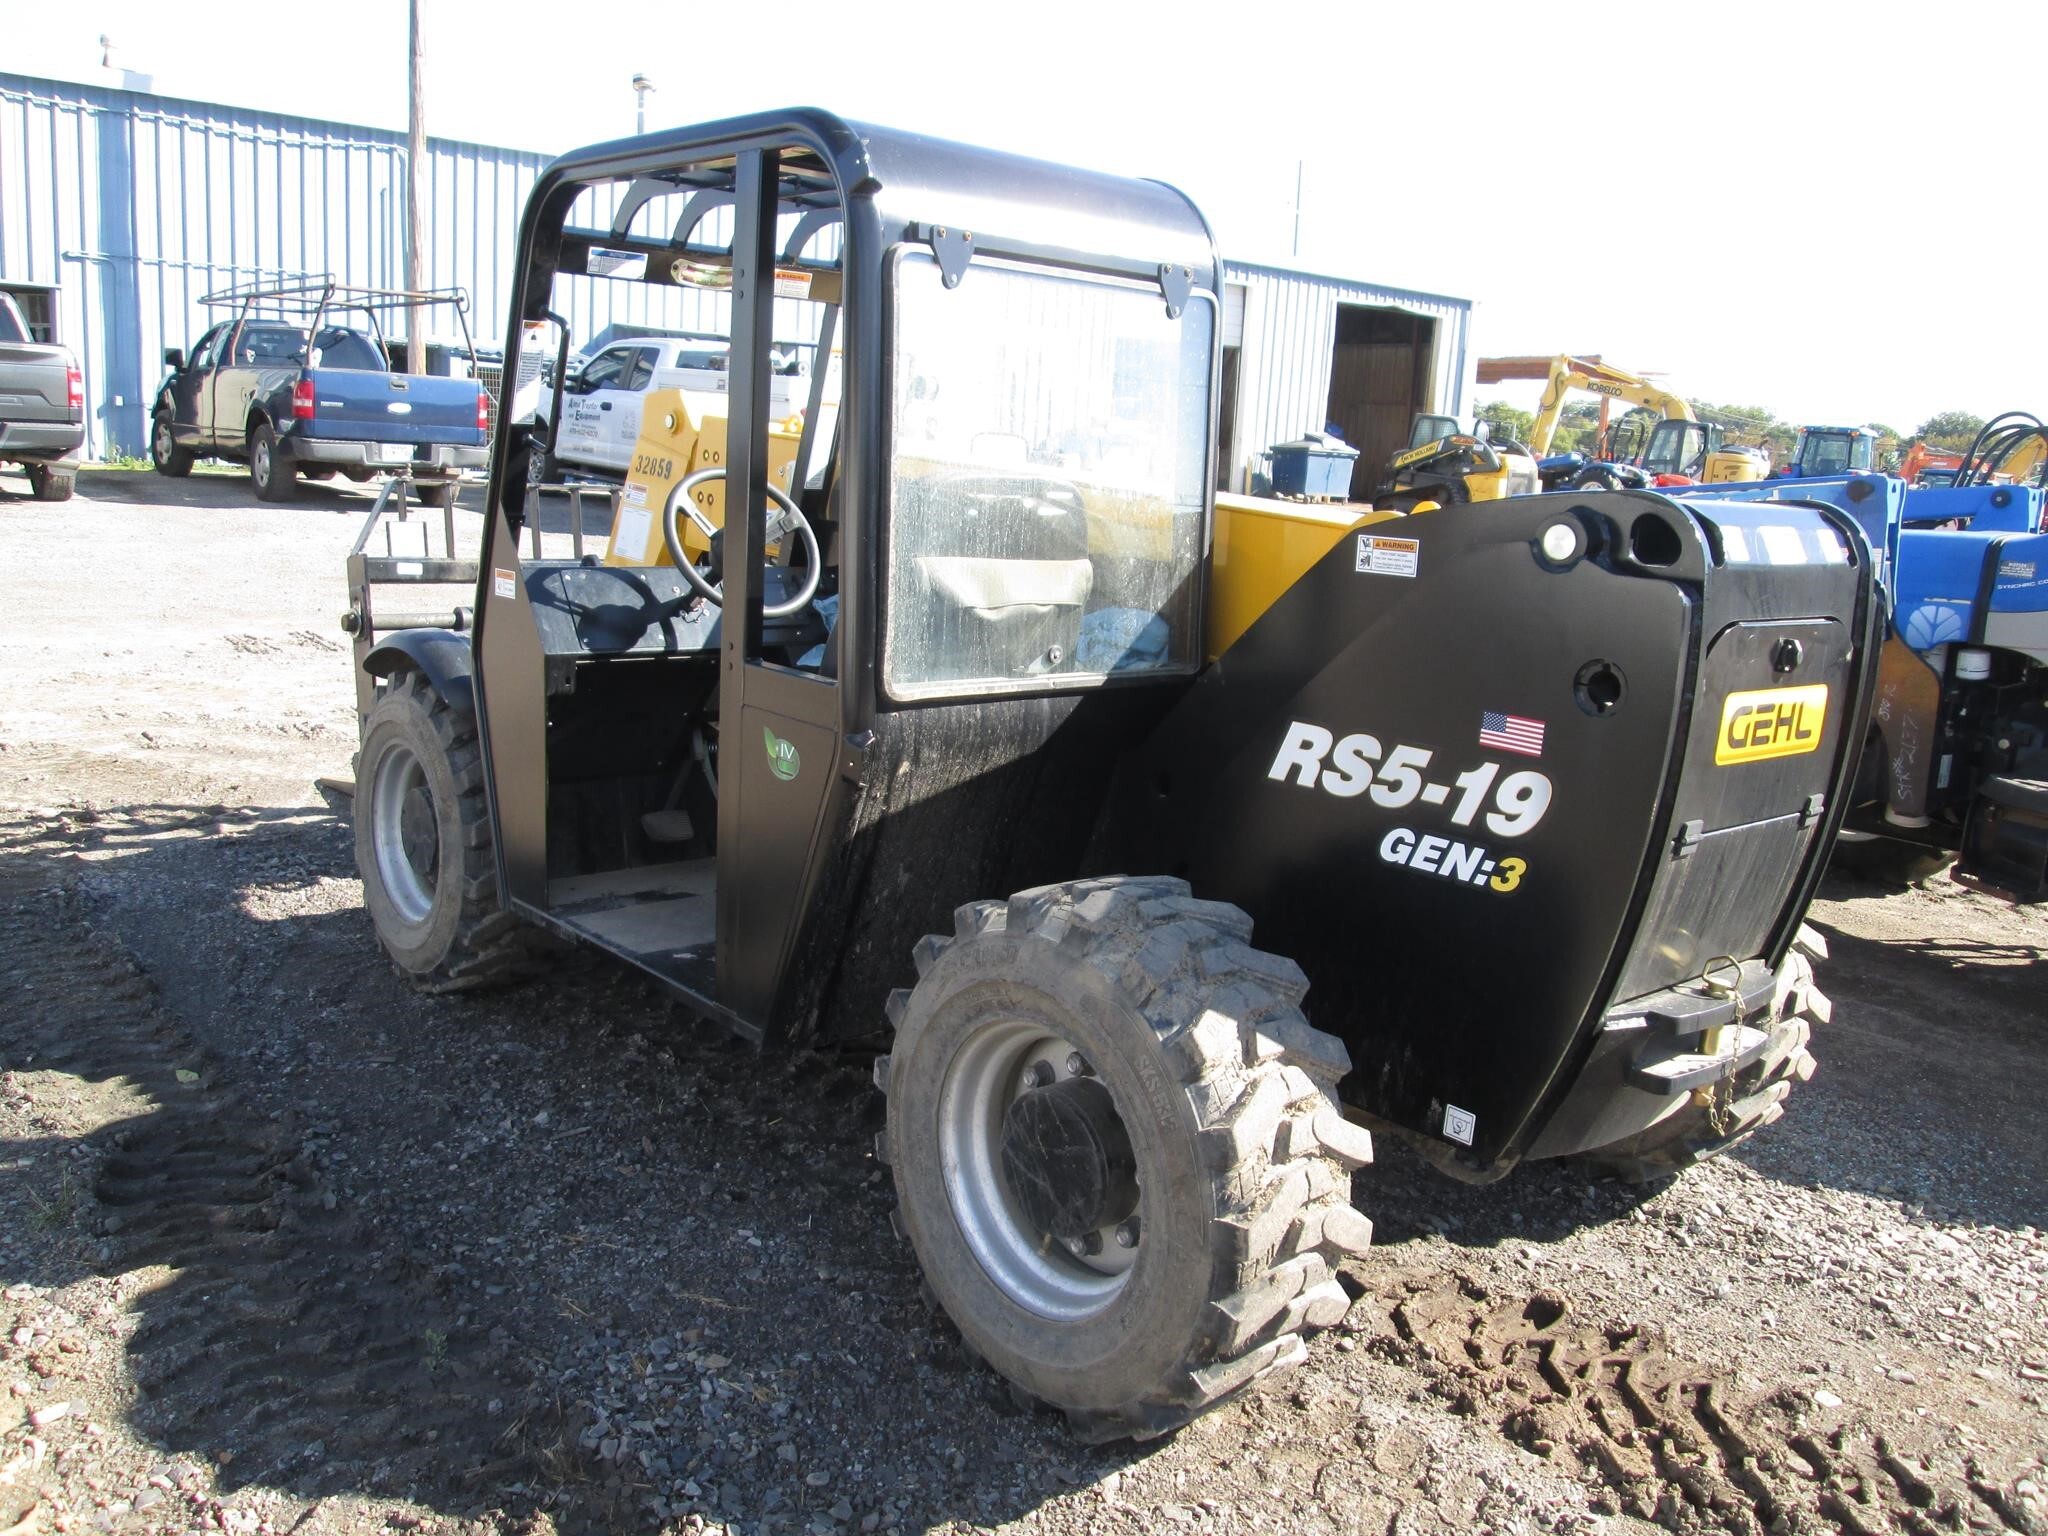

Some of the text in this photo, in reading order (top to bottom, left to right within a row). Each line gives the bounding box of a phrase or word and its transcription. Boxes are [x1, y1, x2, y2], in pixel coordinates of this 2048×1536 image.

[1586, 381, 1623, 397] KOBELCO
[635, 454, 673, 480] 32859
[1382, 541, 1415, 551] WARNING
[1727, 702, 1812, 749] GEHL
[1267, 721, 1552, 837] RS5-19
[1380, 828, 1527, 892] GEN:3
